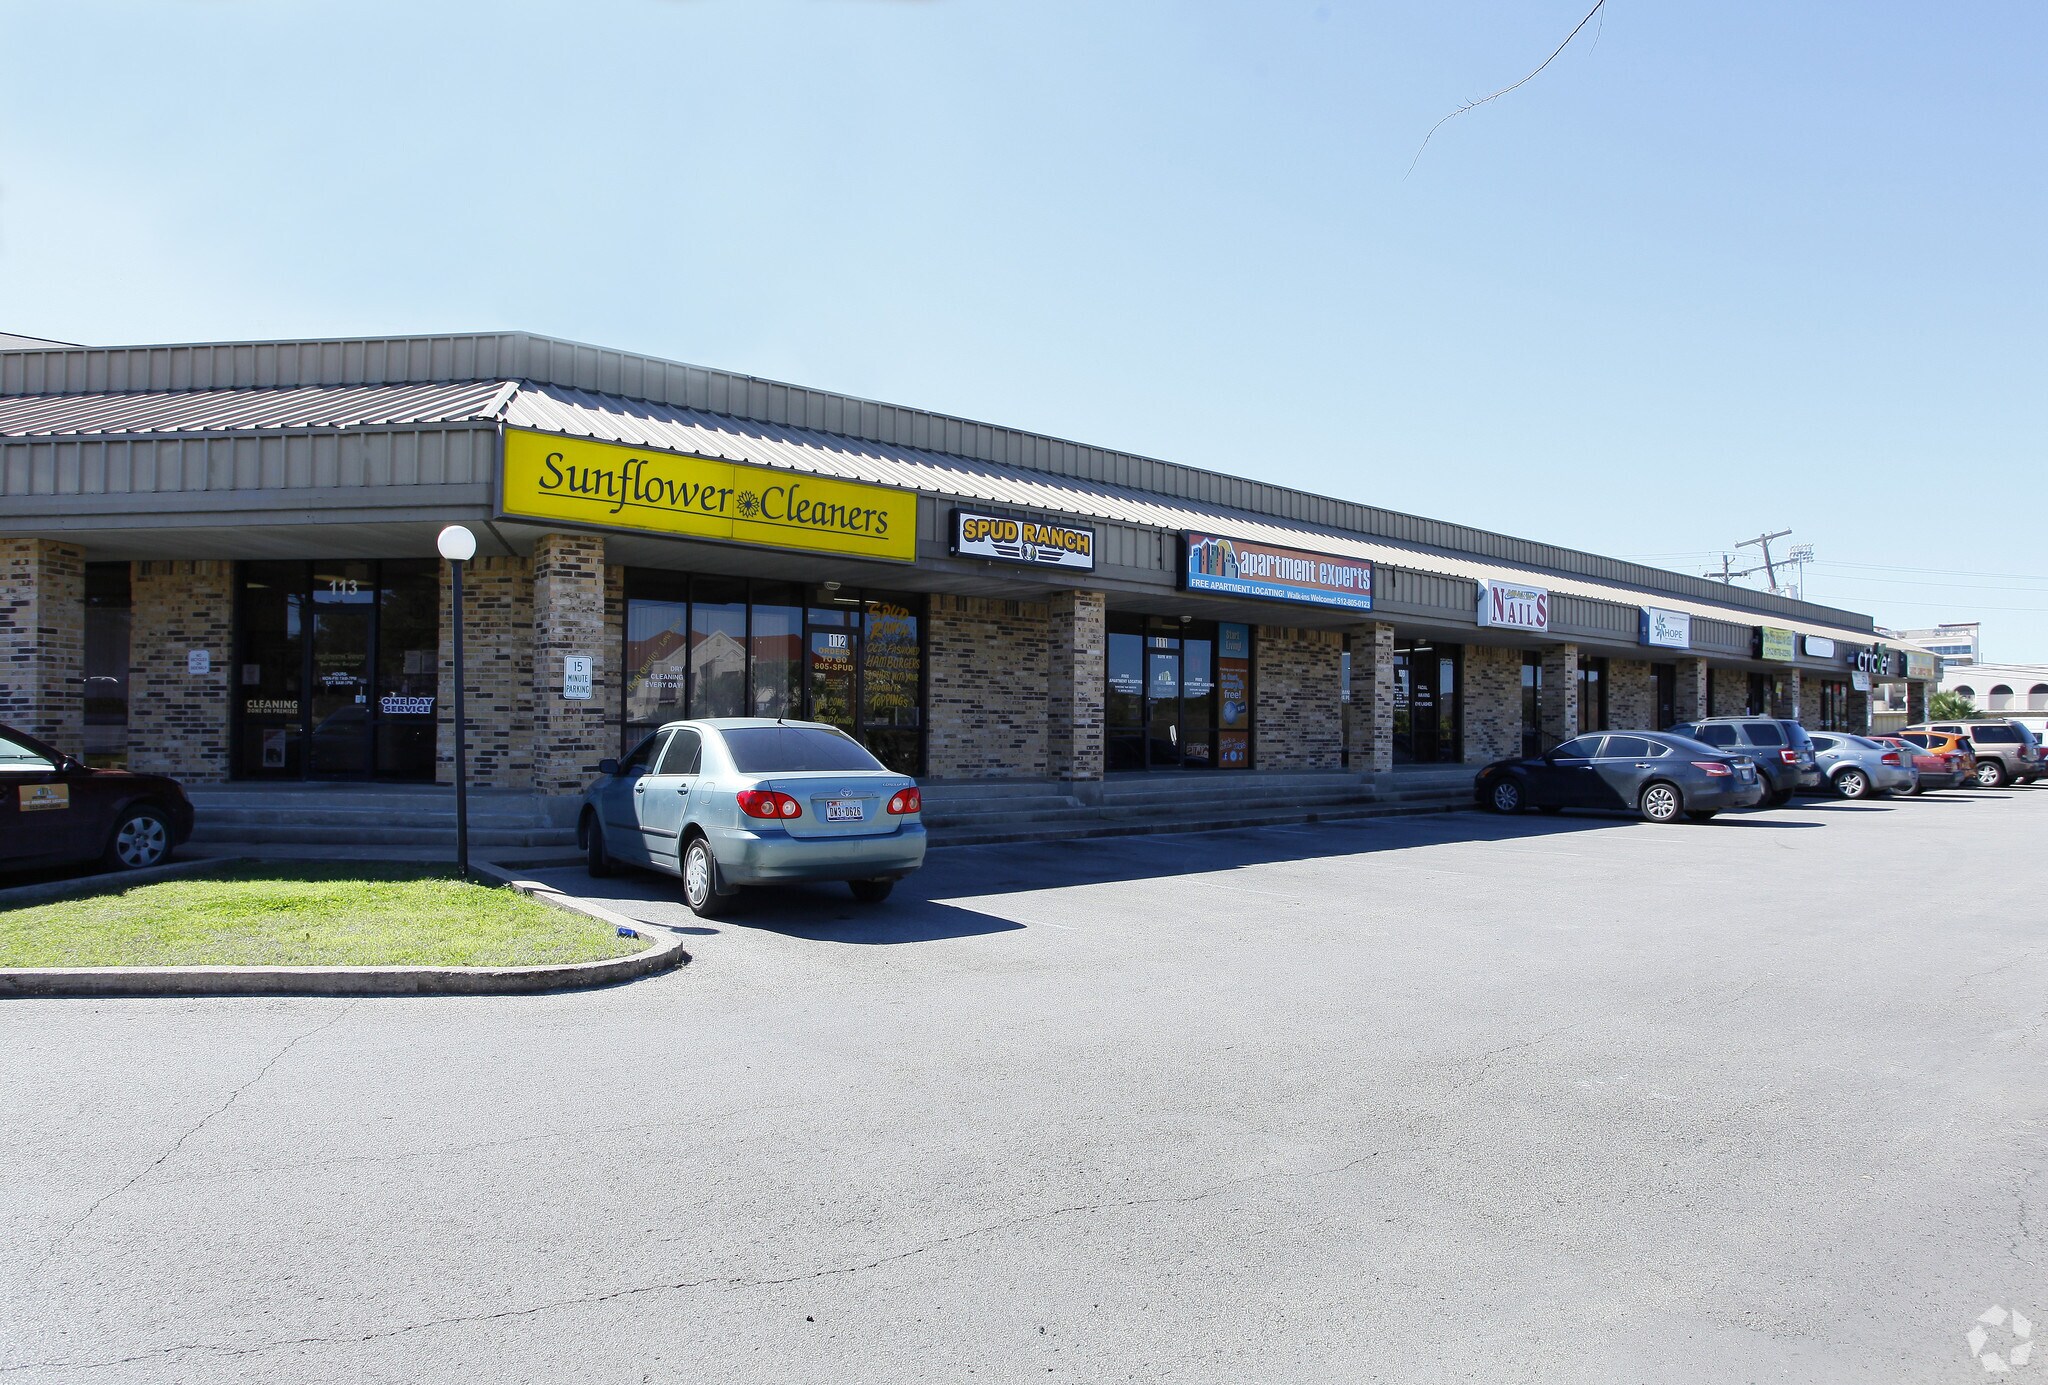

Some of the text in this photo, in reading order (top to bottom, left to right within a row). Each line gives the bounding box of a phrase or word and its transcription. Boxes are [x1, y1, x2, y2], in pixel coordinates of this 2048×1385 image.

[538, 452, 888, 534] Sunflower Cleaners
[963, 518, 1090, 556] SPUD RANCH
[1240, 551, 1370, 590] apartment experts
[328, 580, 358, 596] 113
[1191, 578, 1209, 588] FREE
[1210, 582, 1250, 594] APARTMENT
[1251, 586, 1285, 598] LOCATING!
[868, 602, 910, 620] SPUD
[1492, 586, 1546, 628] NAILS
[1664, 629, 1682, 638] HOPE
[830, 634, 846, 648] 112
[818, 647, 850, 656] ORDERS
[1858, 642, 1890, 675] cricket
[574, 662, 582, 672] 15
[866, 655, 920, 669] HAMBURGERS
[566, 685, 590, 693] PARKING
[1224, 690, 1241, 699] free!
[247, 700, 298, 708] CLEANING
[380, 697, 435, 707] ONE DAY
[870, 693, 908, 710] TOPPINGS
[383, 705, 431, 713] SERVICE
